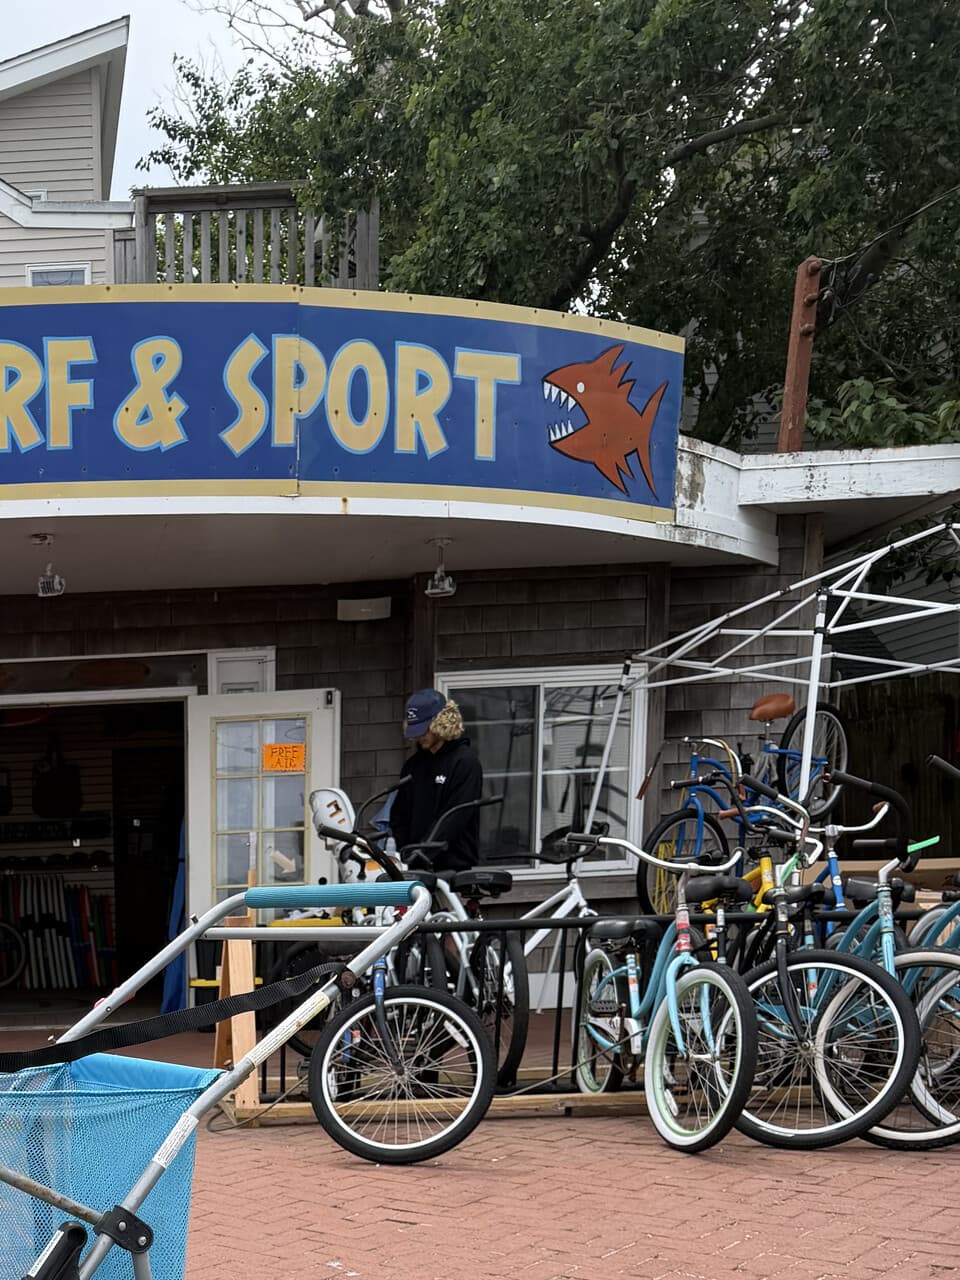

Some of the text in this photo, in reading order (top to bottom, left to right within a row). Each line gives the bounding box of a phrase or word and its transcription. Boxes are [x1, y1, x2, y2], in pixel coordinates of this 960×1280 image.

[112, 336, 189, 453] &
[218, 333, 522, 461] SPORT
[270, 745, 299, 758] FREE
